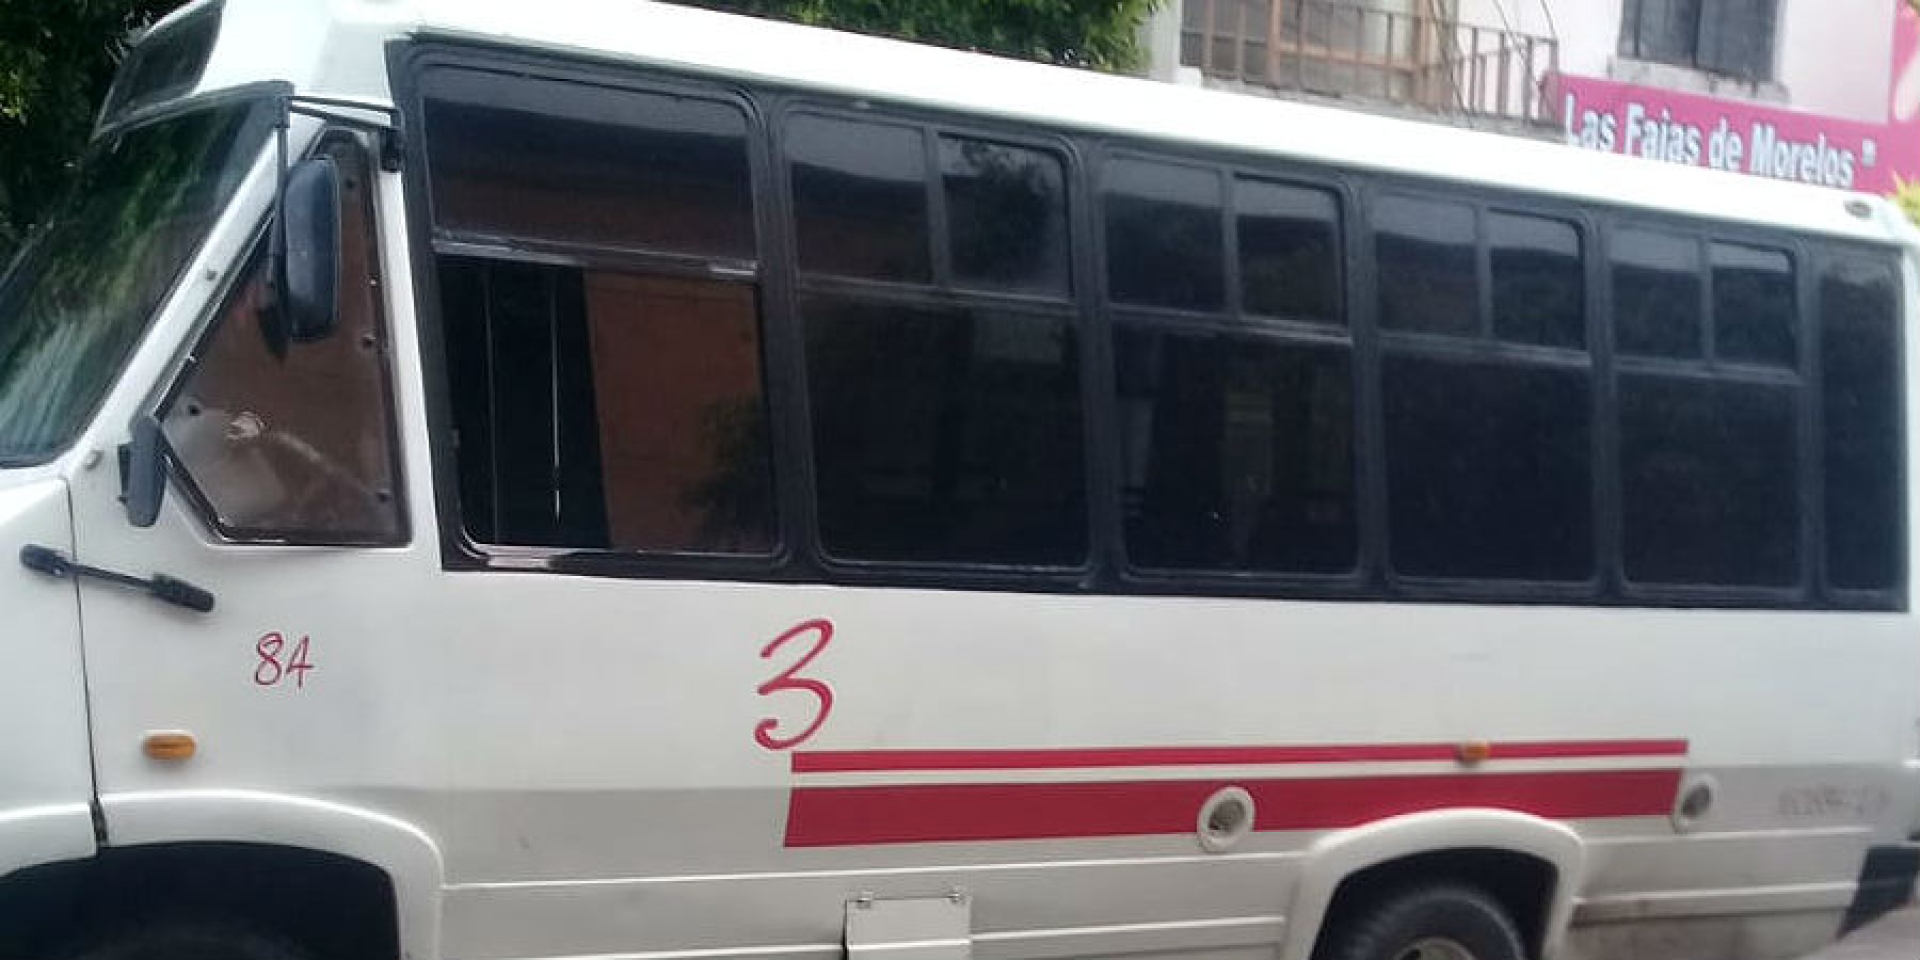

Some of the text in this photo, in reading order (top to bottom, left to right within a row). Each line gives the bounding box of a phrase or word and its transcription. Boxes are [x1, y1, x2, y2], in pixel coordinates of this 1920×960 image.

[1565, 94, 1615, 150] Las
[1708, 117, 1743, 170] de
[1749, 122, 1855, 188] Morelos
[254, 631, 314, 690] 84
[753, 618, 834, 750] 3
